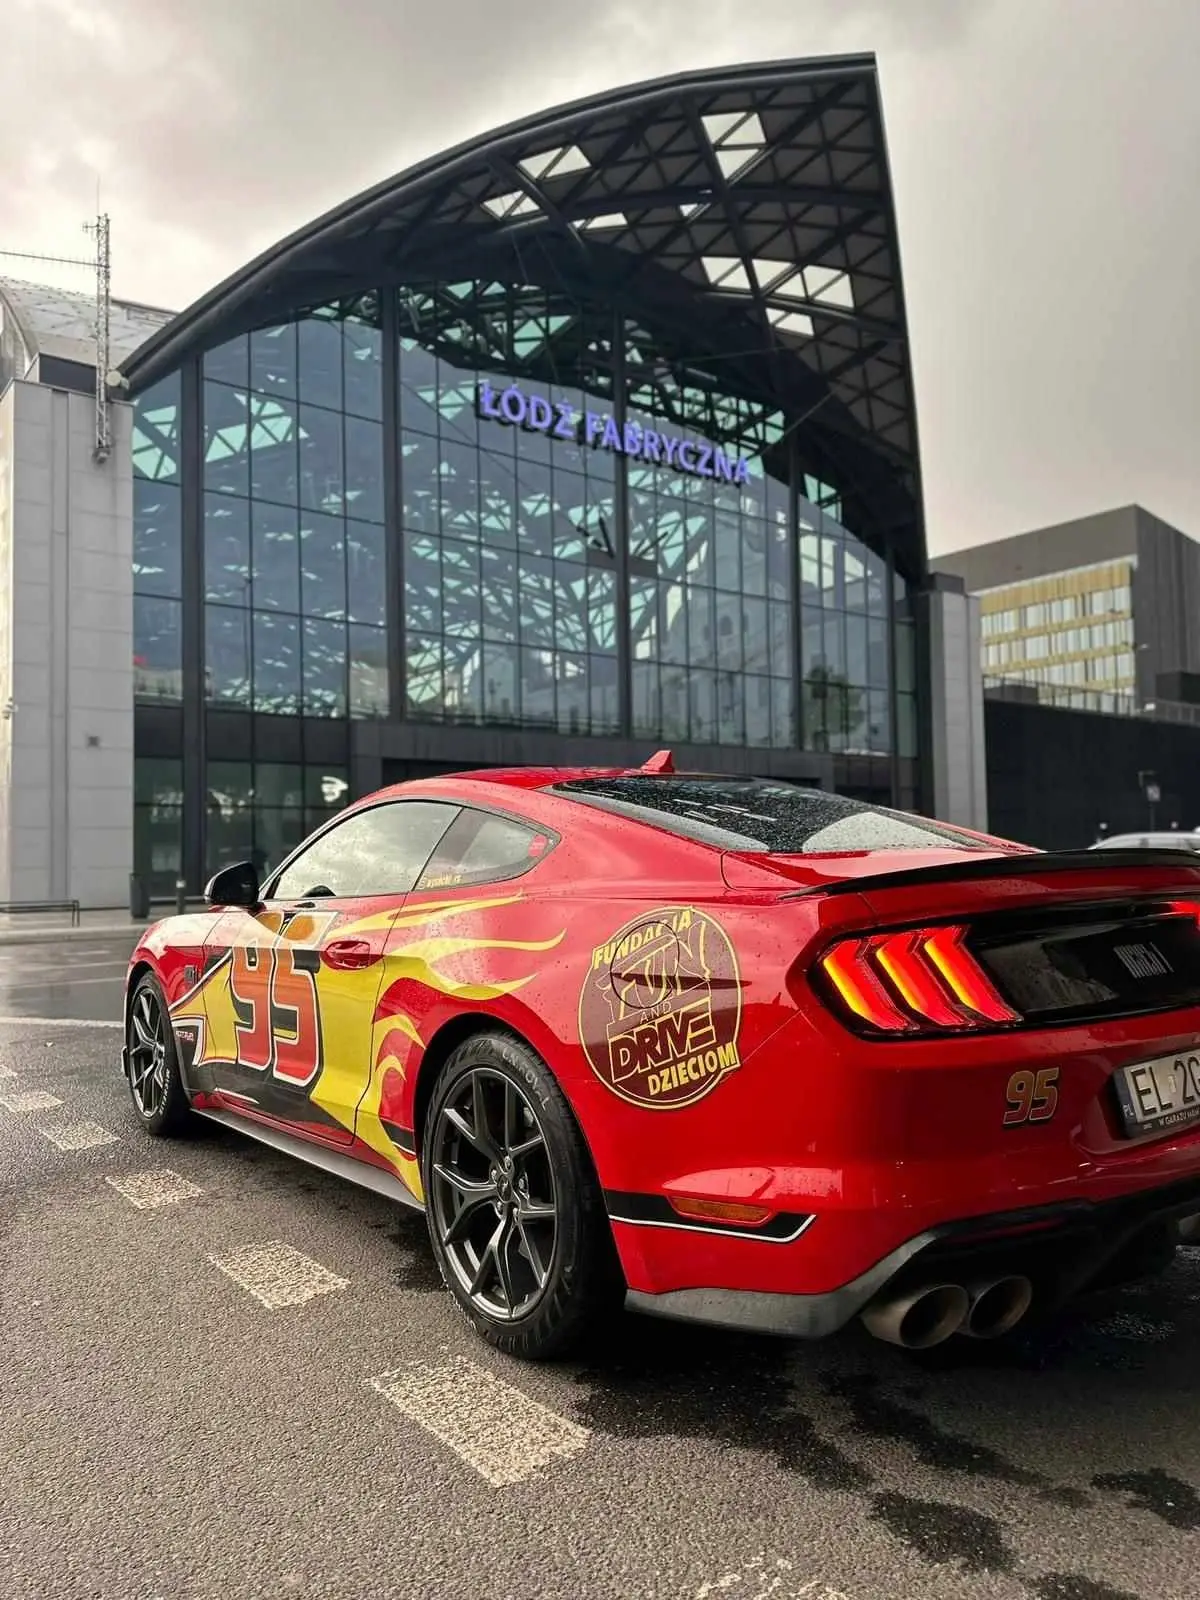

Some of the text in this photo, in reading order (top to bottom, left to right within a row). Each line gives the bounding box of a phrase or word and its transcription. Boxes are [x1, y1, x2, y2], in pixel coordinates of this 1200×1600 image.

[584, 411, 751, 485] FABRYCZNA
[229, 911, 340, 1087] 95
[640, 1001, 672, 1024] AND
[607, 997, 717, 1083] DRIVE
[647, 1043, 738, 1096] DZIECIOM
[1002, 1067, 1060, 1125] 95
[1131, 1066, 1173, 1116] EL
